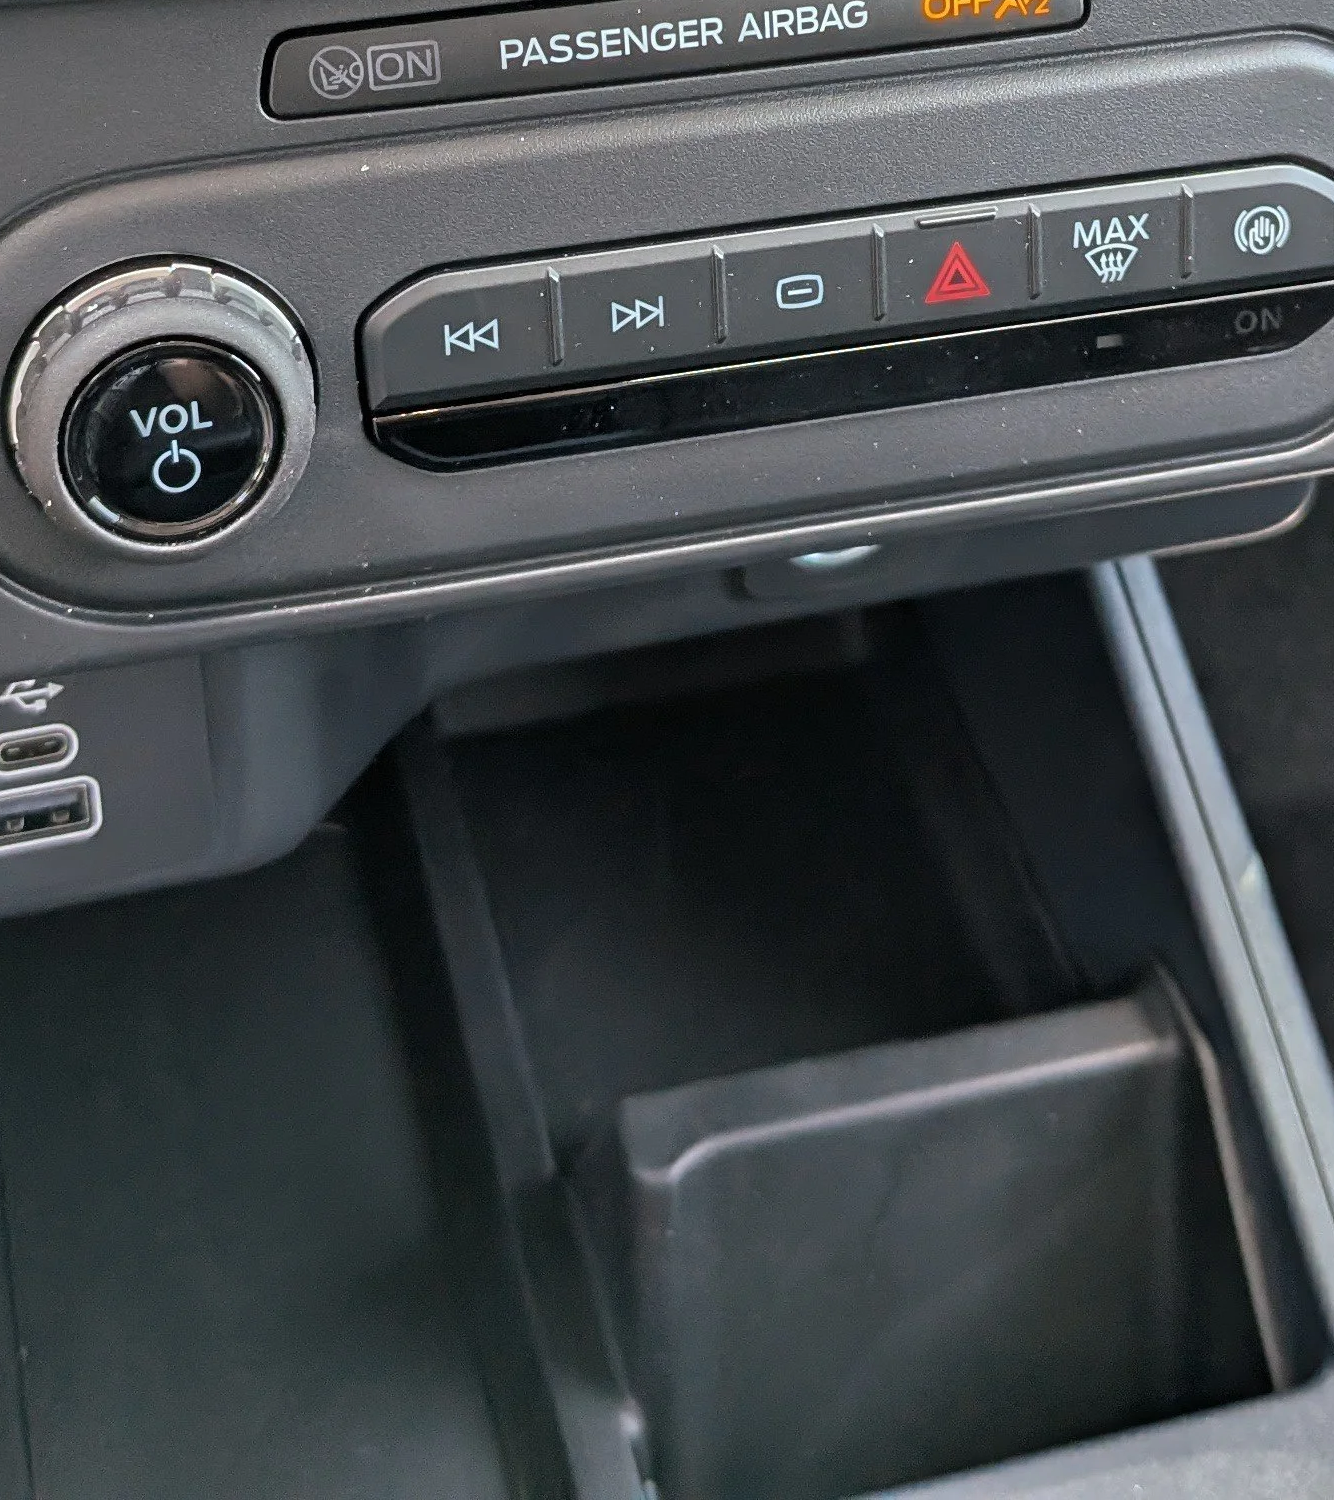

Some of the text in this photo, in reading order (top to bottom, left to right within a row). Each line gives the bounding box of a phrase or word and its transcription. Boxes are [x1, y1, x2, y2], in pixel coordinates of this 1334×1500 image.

[499, 16, 725, 70] PASSENGER
[374, 48, 433, 82] ON
[1071, 211, 1150, 249] MAX
[1233, 306, 1284, 336] ON
[128, 400, 215, 438] VOL
